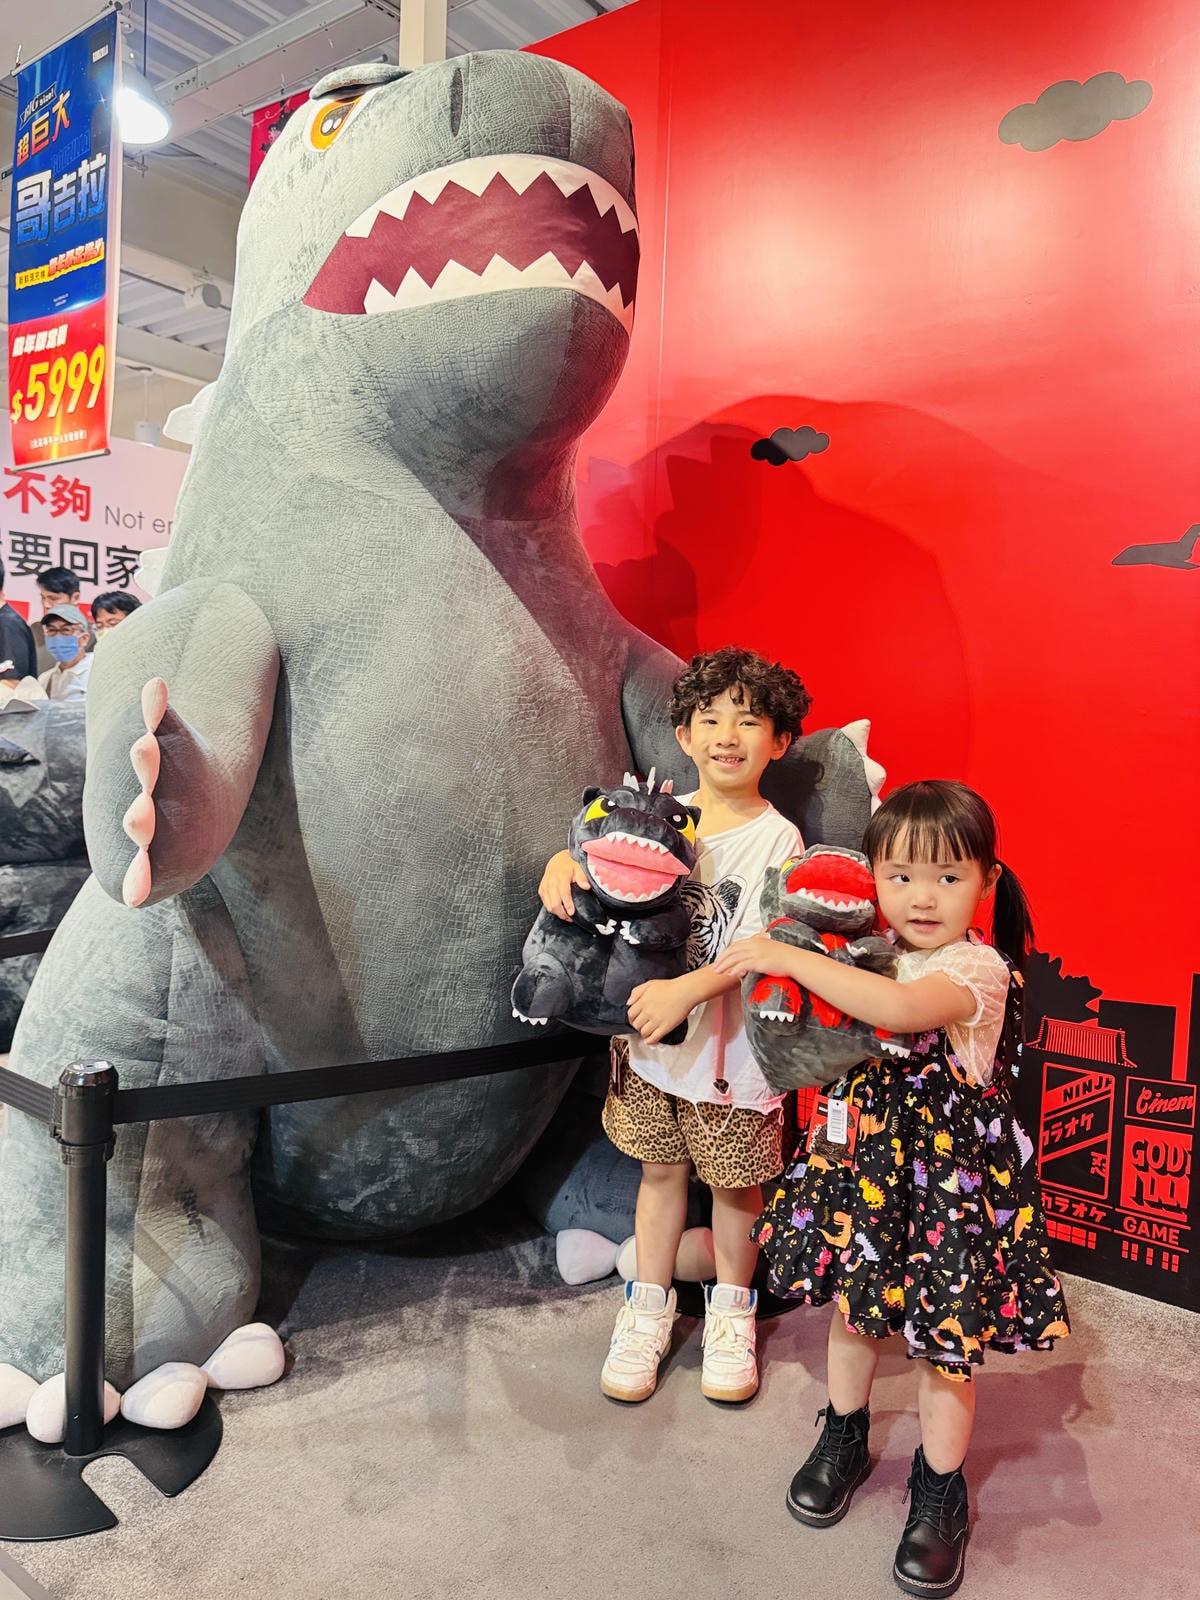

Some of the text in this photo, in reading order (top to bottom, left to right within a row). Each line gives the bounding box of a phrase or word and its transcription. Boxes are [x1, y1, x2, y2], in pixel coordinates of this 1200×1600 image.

[16, 90, 71, 168] 超巨大
[16, 152, 107, 246] 哥吉拉
[10, 343, 105, 425] $5999
[4, 467, 91, 522] 不夠
[104, 505, 144, 531] Not
[0, 529, 142, 588] 要回家
[1123, 1216, 1181, 1246] GAME
